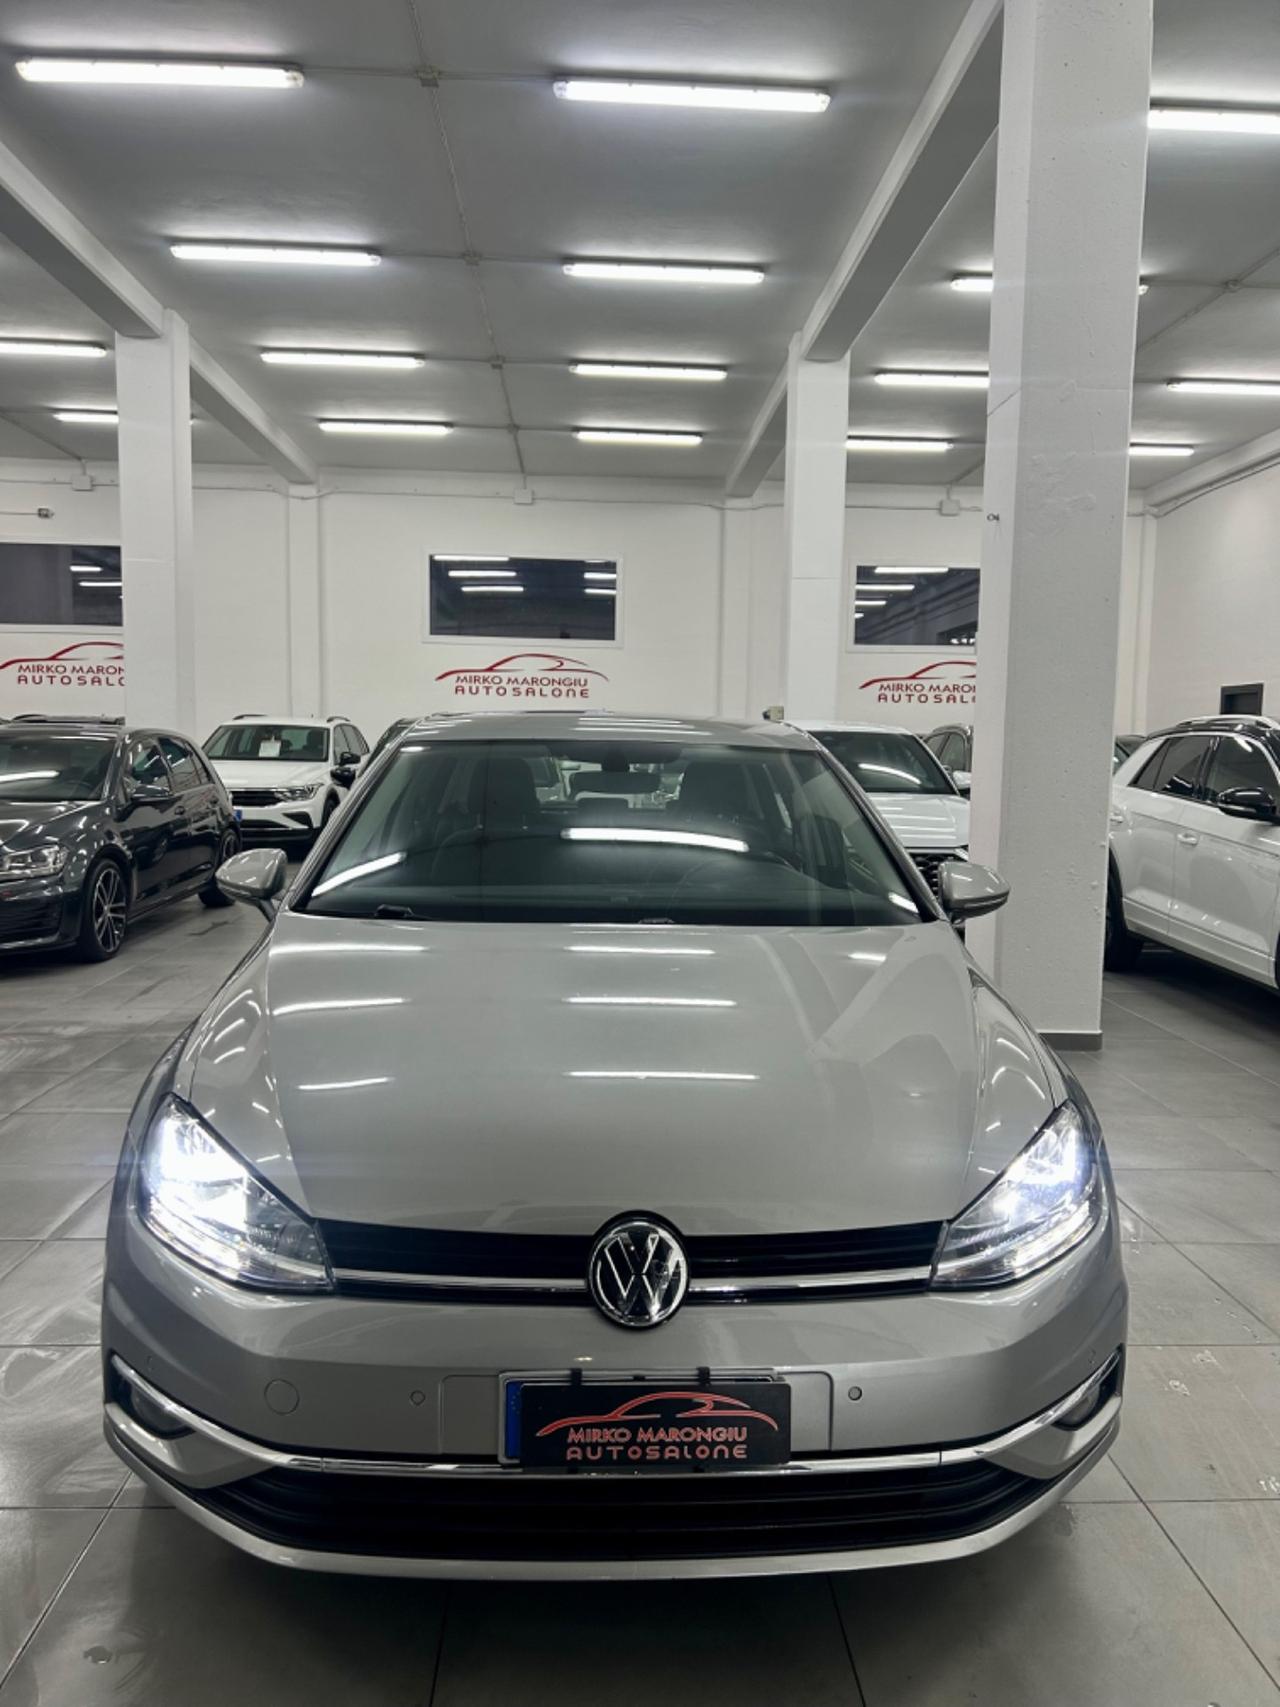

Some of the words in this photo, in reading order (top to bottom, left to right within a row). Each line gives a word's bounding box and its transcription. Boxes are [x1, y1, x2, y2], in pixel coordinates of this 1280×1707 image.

[17, 664, 67, 674] MIRKO
[455, 675, 503, 685] MIRKO
[506, 677, 588, 687] MARONGIU
[454, 685, 589, 698] AUTOSALONE
[878, 683, 925, 692] MIRKO
[567, 1427, 632, 1443] MIRKO
[636, 1426, 748, 1442] MARONGIU
[566, 1444, 748, 1461] AUTOSALONE
